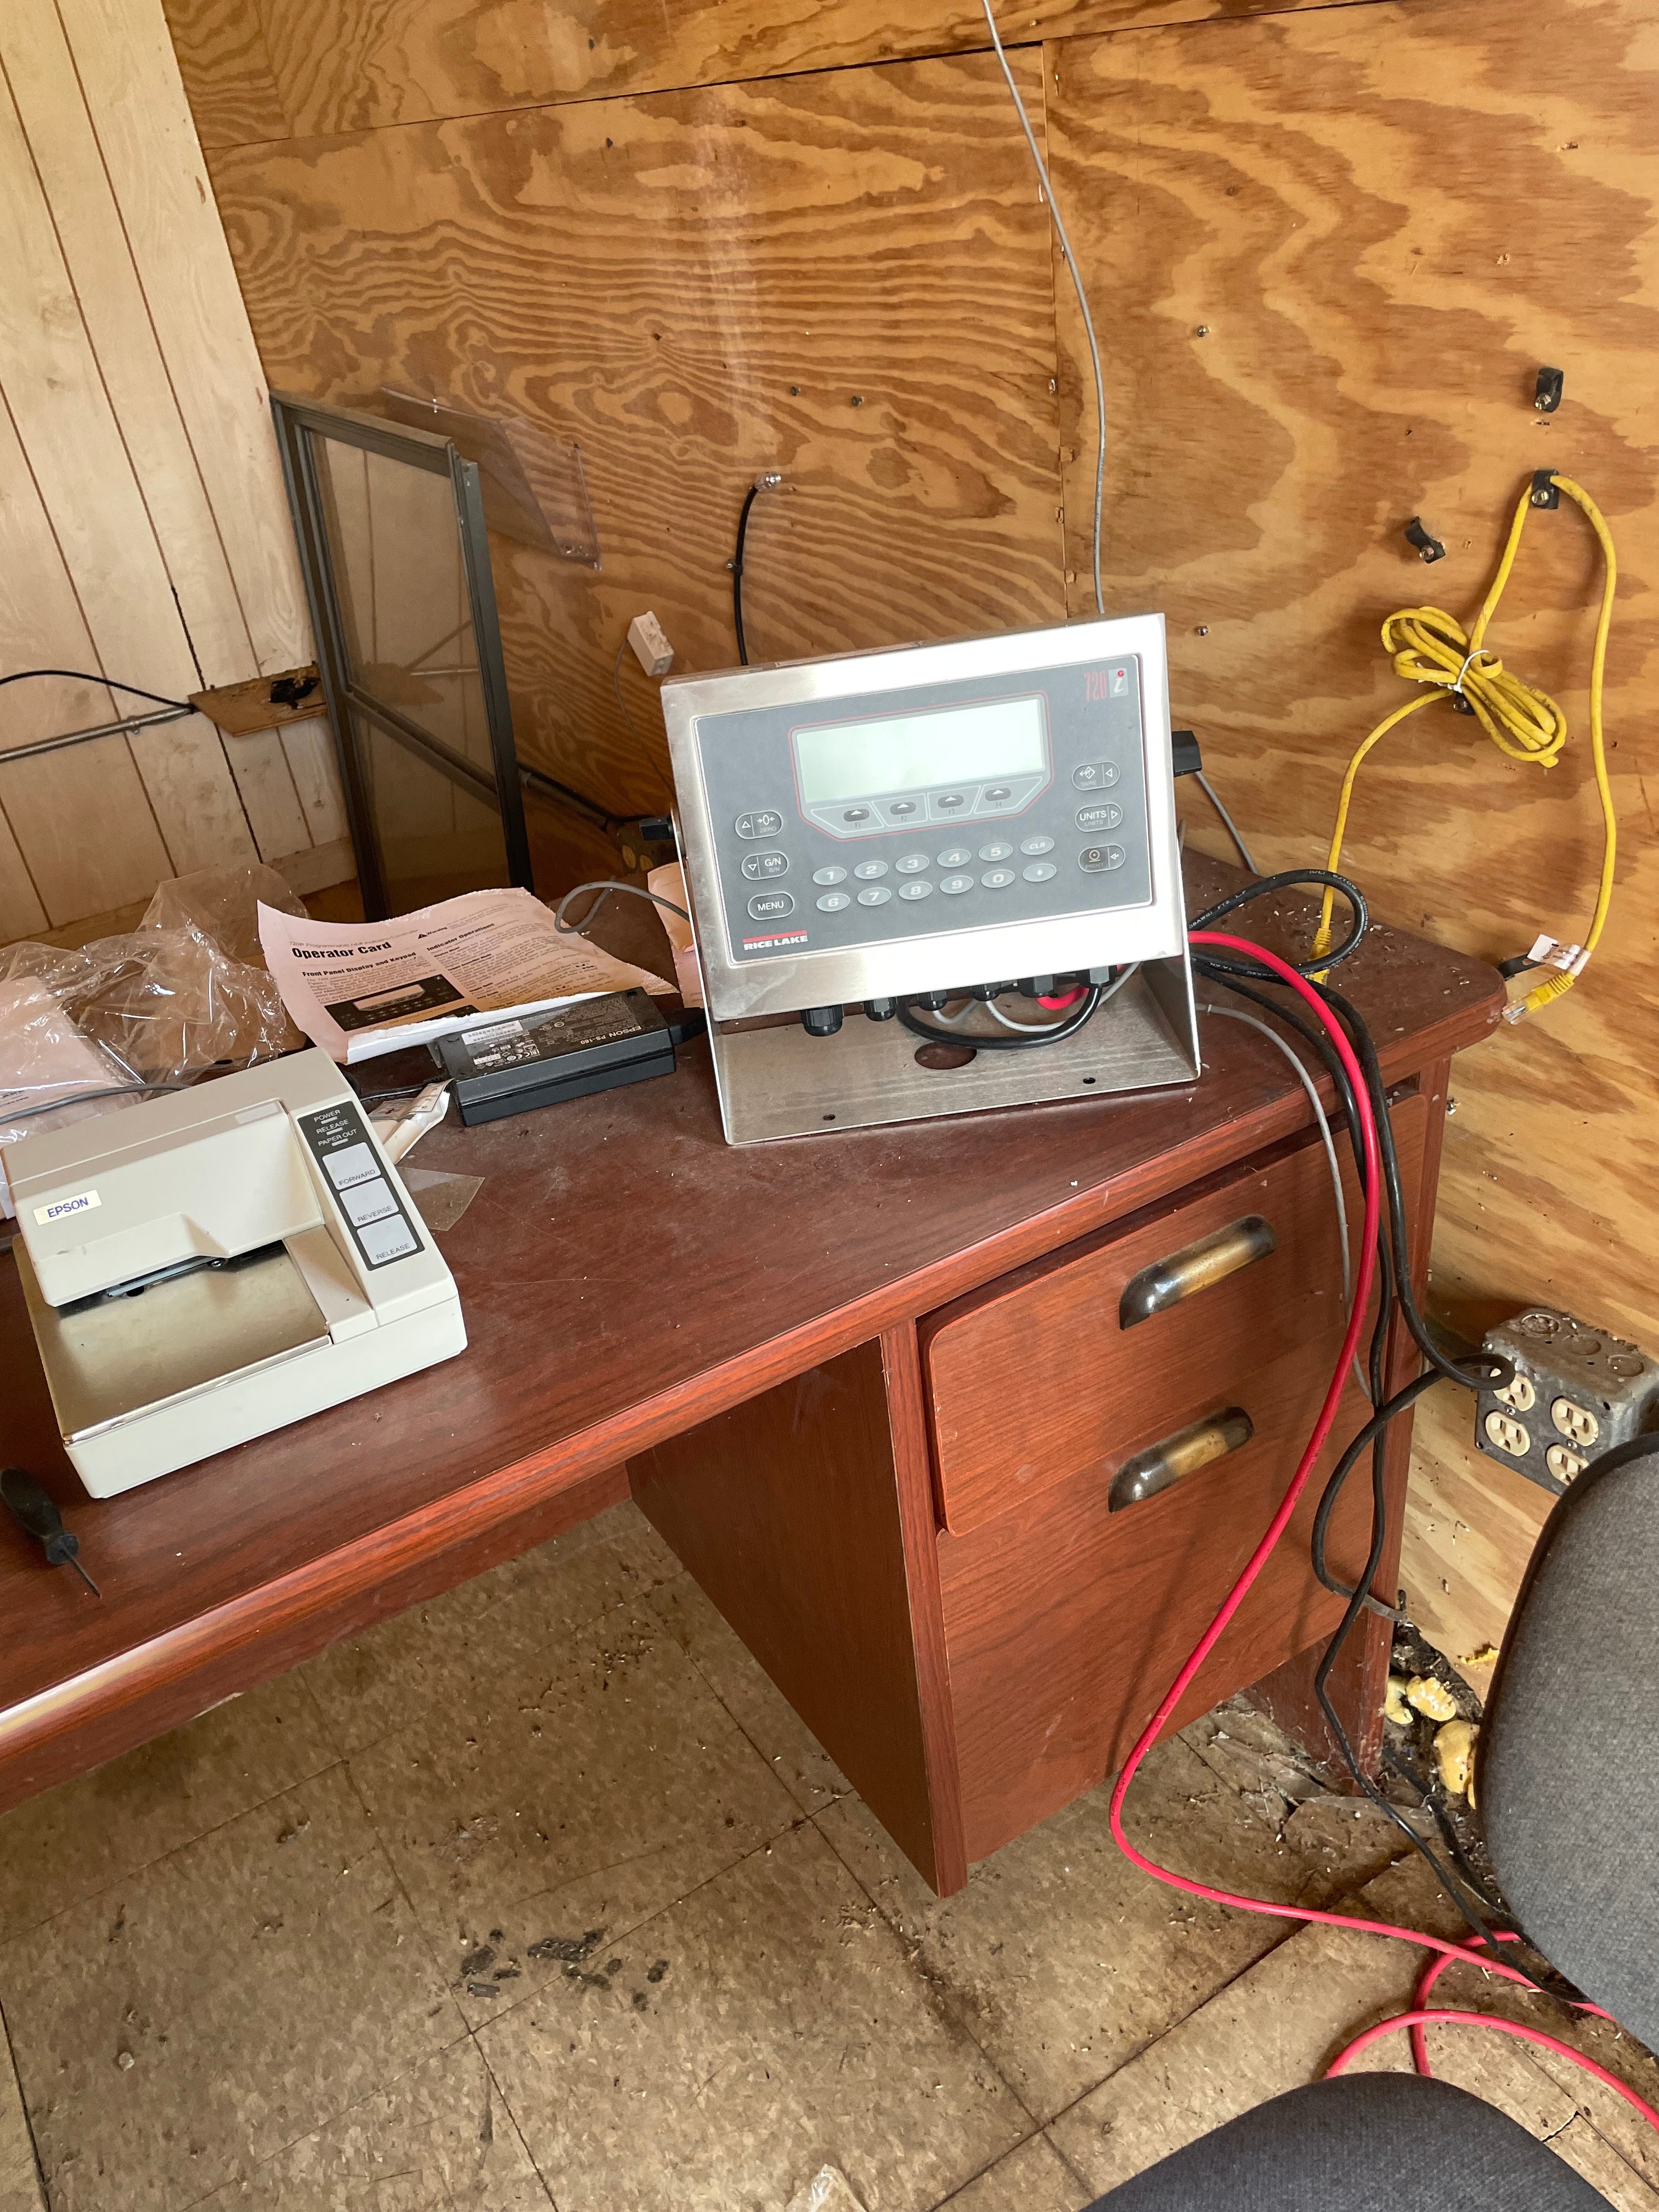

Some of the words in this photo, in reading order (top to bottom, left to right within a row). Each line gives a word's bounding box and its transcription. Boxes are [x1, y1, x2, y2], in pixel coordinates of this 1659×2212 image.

[1079, 810, 1107, 821] UNITS
[764, 857, 782, 867] G/N
[826, 871, 834, 880] 1
[866, 865, 877, 875] 2
[907, 859, 918, 868] 3
[949, 853, 961, 862] 4
[990, 847, 1001, 856] 5
[827, 898, 839, 907] 6
[868, 892, 880, 901] 7
[910, 886, 922, 895] 8
[951, 880, 963, 889] 9
[992, 874, 1004, 883] 0
[757, 900, 785, 911] MENU
[427, 938, 458, 951] Indicator
[458, 923, 495, 939] Operations
[743, 940, 773, 951] RICE
[774, 935, 808, 946] LAKE
[292, 948, 354, 959] Operator
[357, 941, 392, 954] Card
[346, 964, 374, 973] Display
[390, 952, 417, 962] Keypad
[608, 1025, 642, 1037] EPSON
[313, 1109, 341, 1122] POWER
[315, 1119, 349, 1134] RELEASE
[318, 1135, 342, 1147] PAPER
[342, 1128, 357, 1138] OUT
[338, 1169, 376, 1186] FORWARD
[47, 1197, 89, 1218] EPSON
[357, 1206, 393, 1222] REVERSE
[376, 1243, 411, 1260] RELEASE
